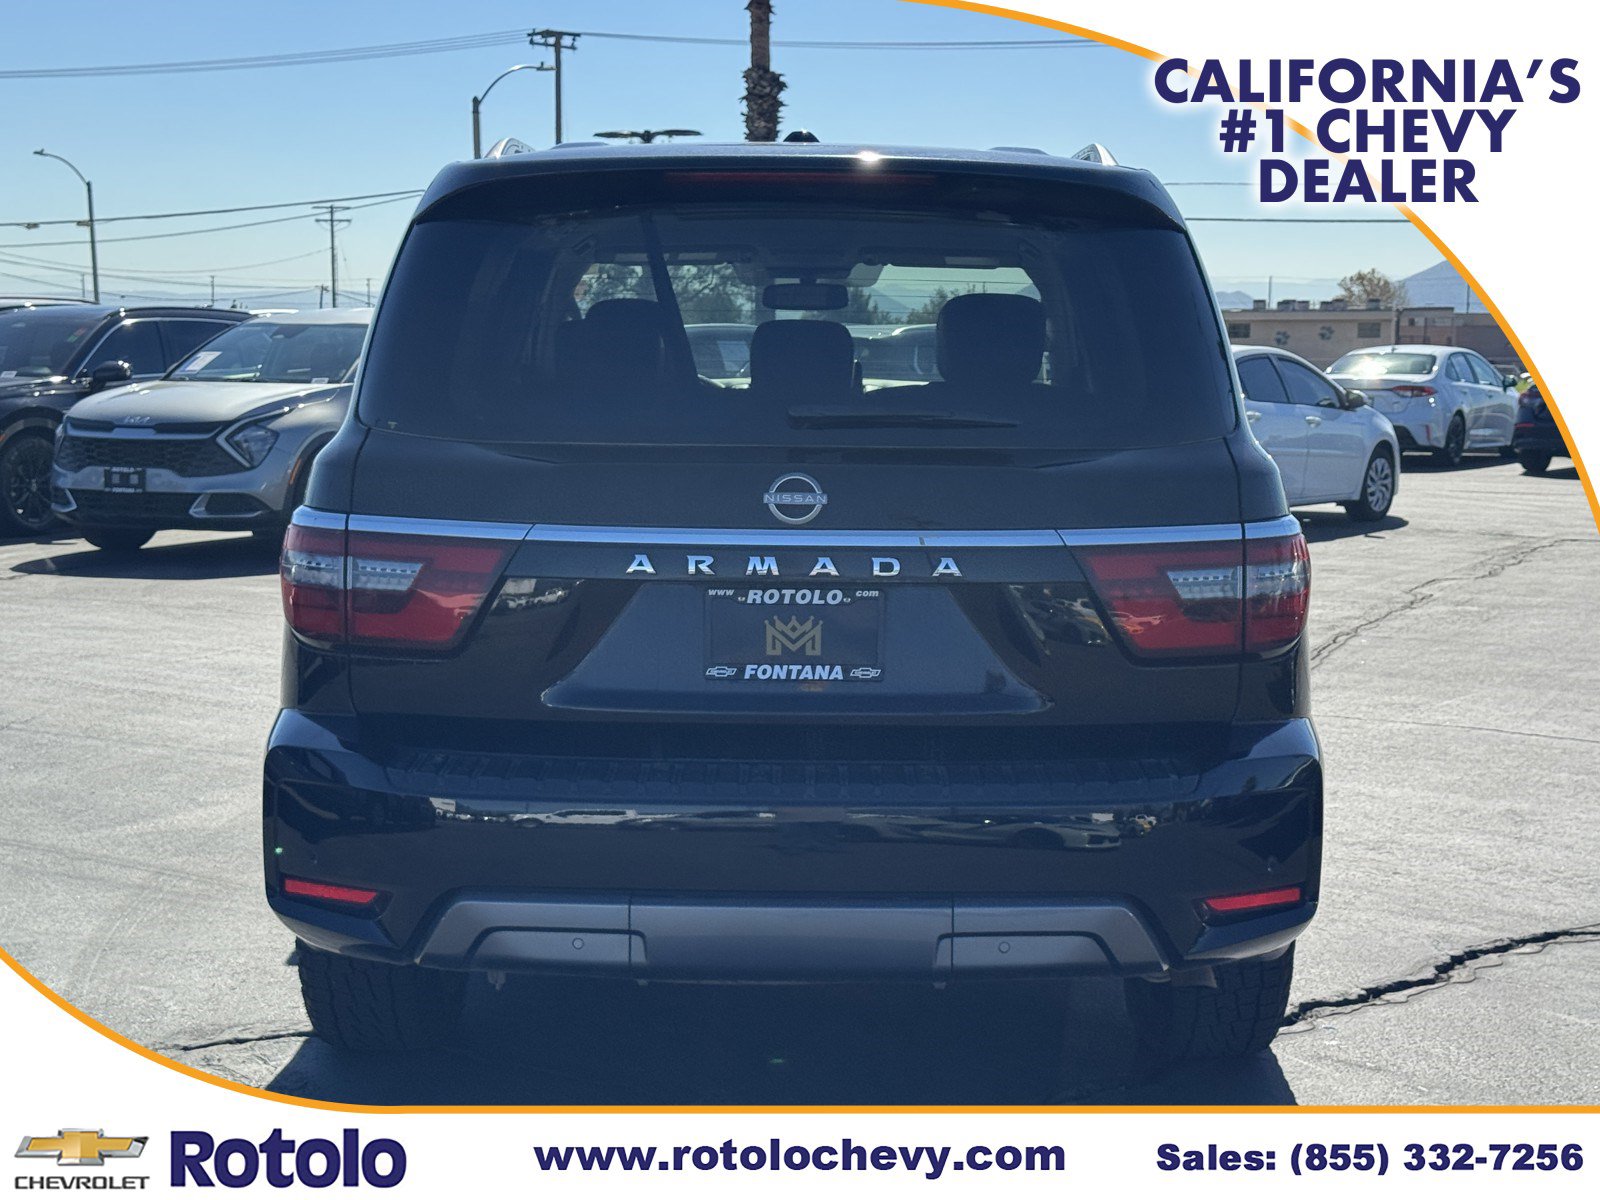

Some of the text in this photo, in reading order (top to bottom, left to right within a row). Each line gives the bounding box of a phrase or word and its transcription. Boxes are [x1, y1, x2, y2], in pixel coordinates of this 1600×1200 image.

[765, 494, 826, 503] NISSAN
[625, 554, 963, 577] ARMADA
[747, 589, 843, 605] ROTOLO
[744, 664, 844, 680] FONTANA
